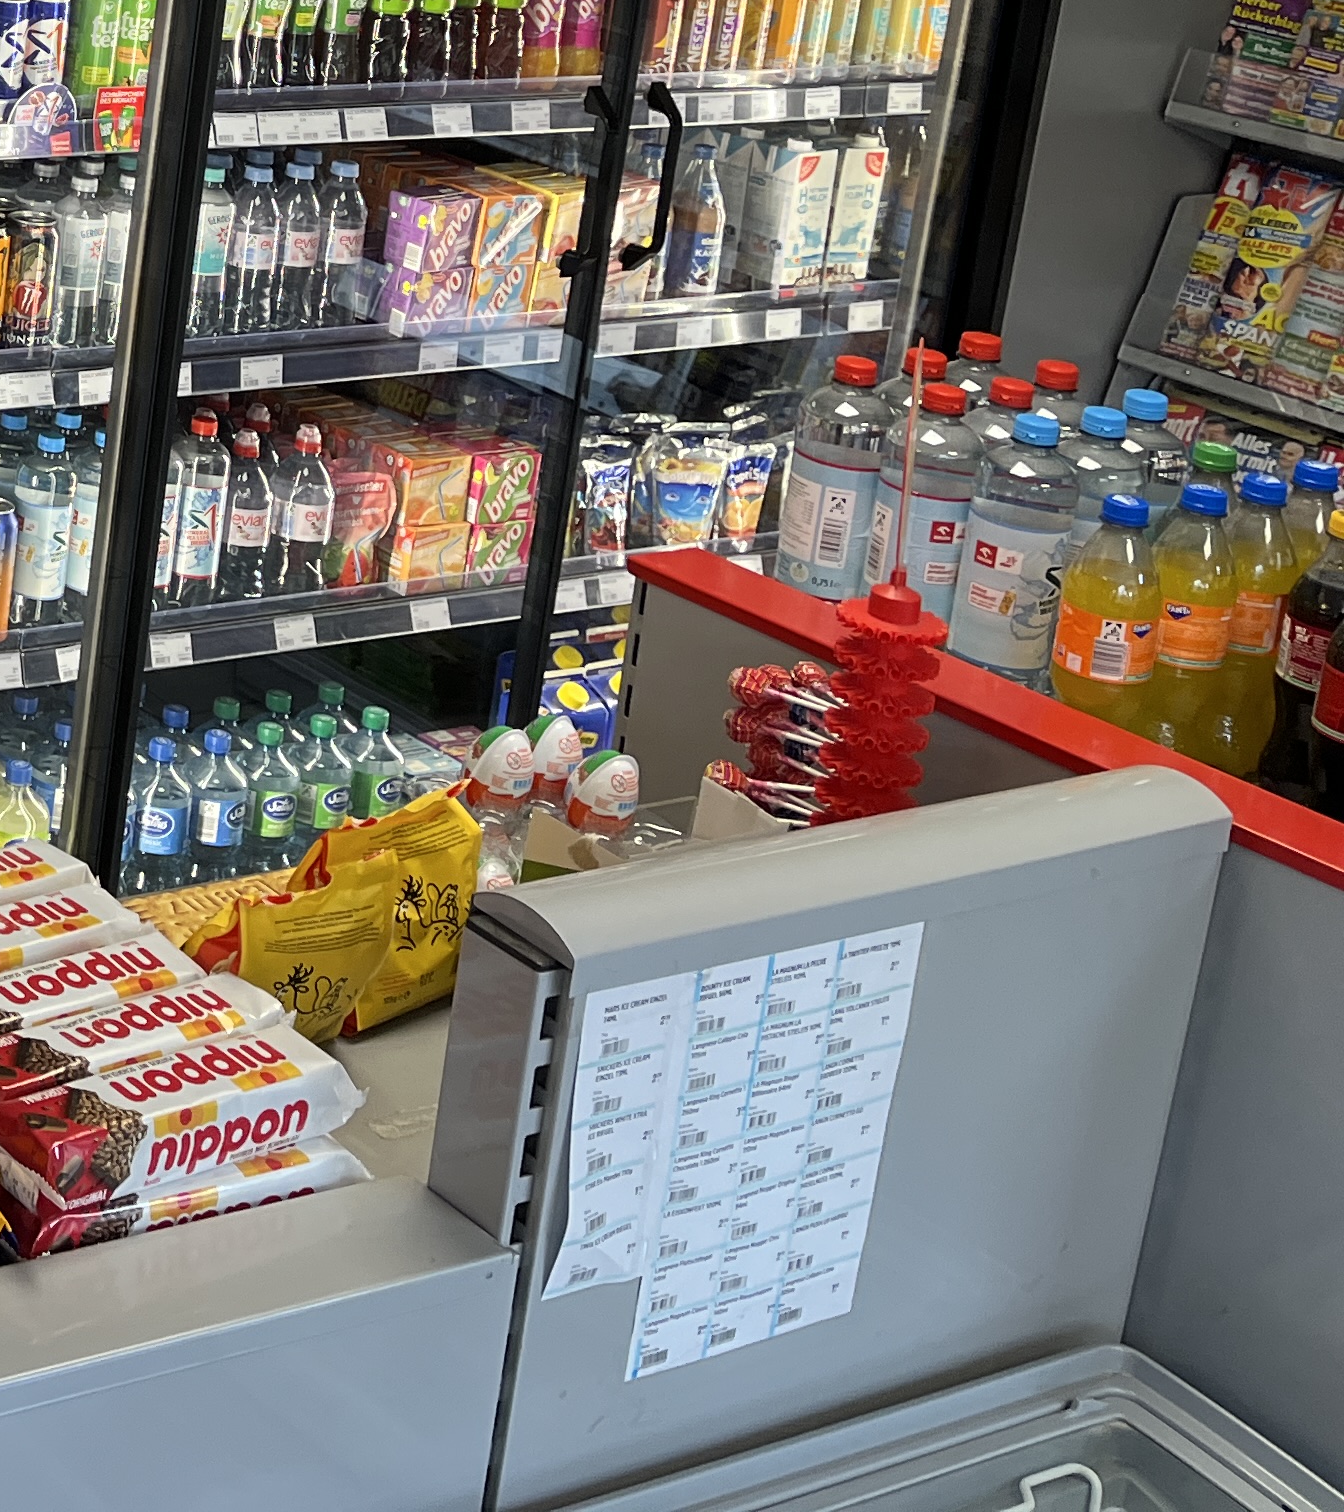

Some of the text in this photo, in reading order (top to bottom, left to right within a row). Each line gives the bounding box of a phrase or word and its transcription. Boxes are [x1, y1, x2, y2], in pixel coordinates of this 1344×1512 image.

[1233, 5, 1302, 34] Rückschlag
[431, 200, 472, 272] bravo
[1266, 242, 1293, 254] HITS
[413, 269, 464, 336] bravo
[476, 264, 523, 331] bravo
[1231, 432, 1272, 454] Alles
[484, 456, 532, 522] bravo
[476, 524, 522, 585] bravo
[61, 988, 233, 1049] nippon
[109, 1038, 287, 1102] nippon
[146, 1099, 310, 1178] nippon
